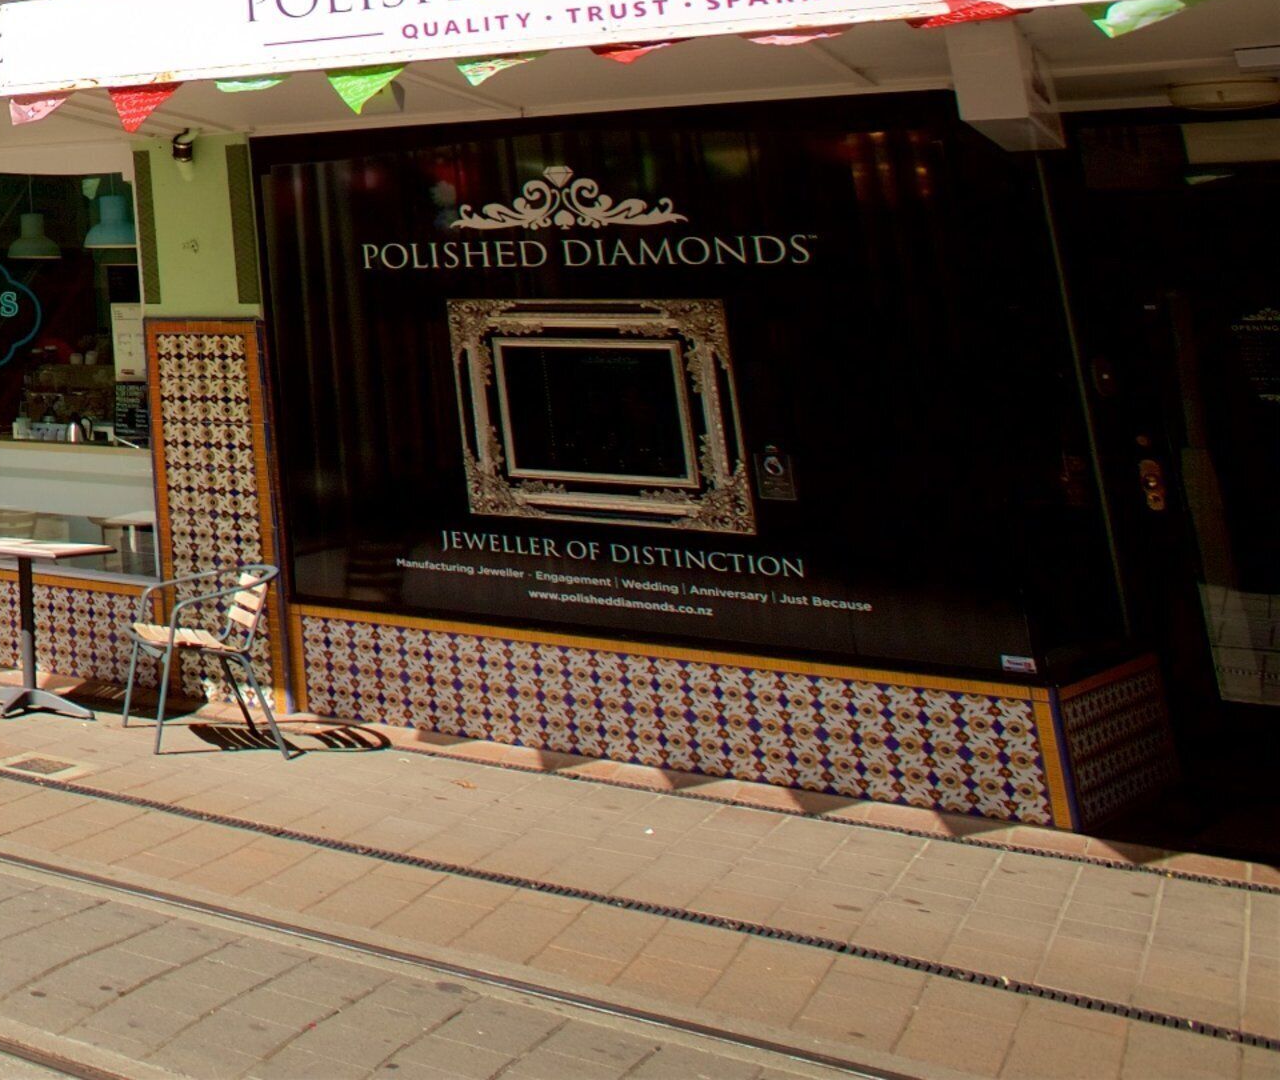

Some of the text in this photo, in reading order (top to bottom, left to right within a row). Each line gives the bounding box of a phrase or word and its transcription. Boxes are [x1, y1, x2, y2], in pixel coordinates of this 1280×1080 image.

[401, 11, 534, 41] QUALITY
[362, 240, 548, 270] POLISHED
[441, 529, 807, 580] JEWELLER OF DISTINCTION
[396, 559, 873, 612] Manufacturing Jeweller Engagement Wedding Anniversary Just Because
[528, 588, 714, 617] www.polisheddiamonds.co.nz
